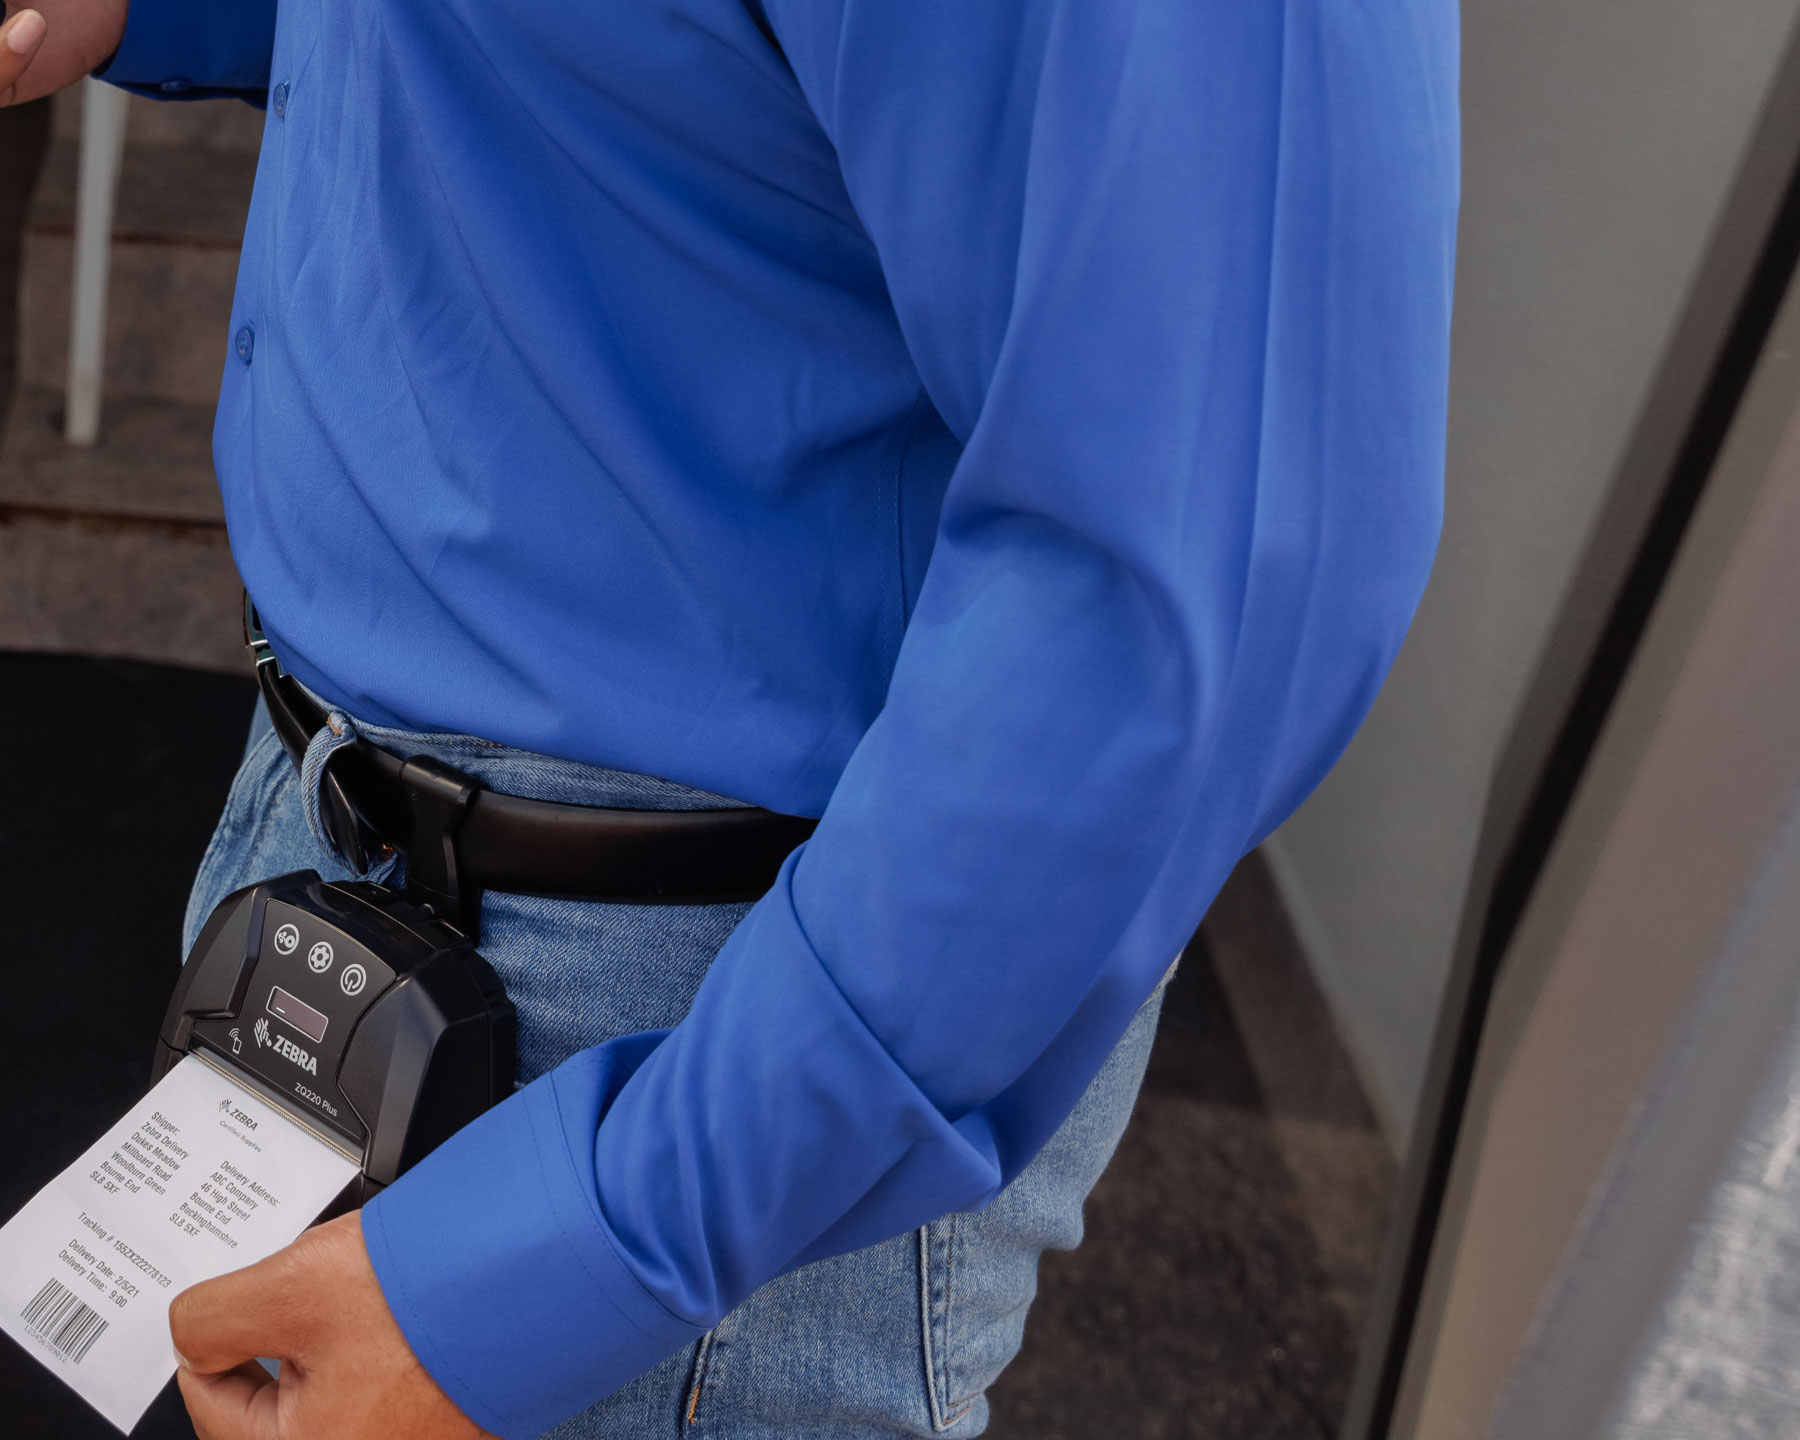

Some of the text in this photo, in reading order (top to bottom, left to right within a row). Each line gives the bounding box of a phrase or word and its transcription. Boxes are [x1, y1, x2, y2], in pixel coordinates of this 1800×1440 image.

[272, 1034, 317, 1076] ZEBRA
[295, 1082, 338, 1117] ZQ220 Plus
[151, 1111, 180, 1136] Shipper:
[219, 1120, 261, 1153] Certified Supplies
[229, 1108, 258, 1131] ZEBRA
[131, 1132, 181, 1171] Dukes Meadow
[141, 1121, 189, 1160] Zebra Delivery
[100, 1161, 141, 1194] Bourne End
[111, 1151, 166, 1195] Woodburn Green
[121, 1142, 173, 1182] Millboard Road
[89, 1170, 120, 1194] SL8 5XF
[201, 1182, 251, 1221] 46 High Street
[210, 1172, 259, 1210] ABC Company
[220, 1160, 280, 1207] Delivery Address:
[169, 1213, 201, 1237] SL8 5XF
[179, 1202, 238, 1248] Buckinghamshire
[189, 1192, 232, 1225] Bourne End
[68, 1238, 140, 1298] Delivery Date: 2/5/21
[78, 1211, 172, 1288] Tracking # 155ZX222278123
[58, 1249, 128, 1308] Delivery Time: 9:00
[24, 1324, 68, 1364] 123456789012
